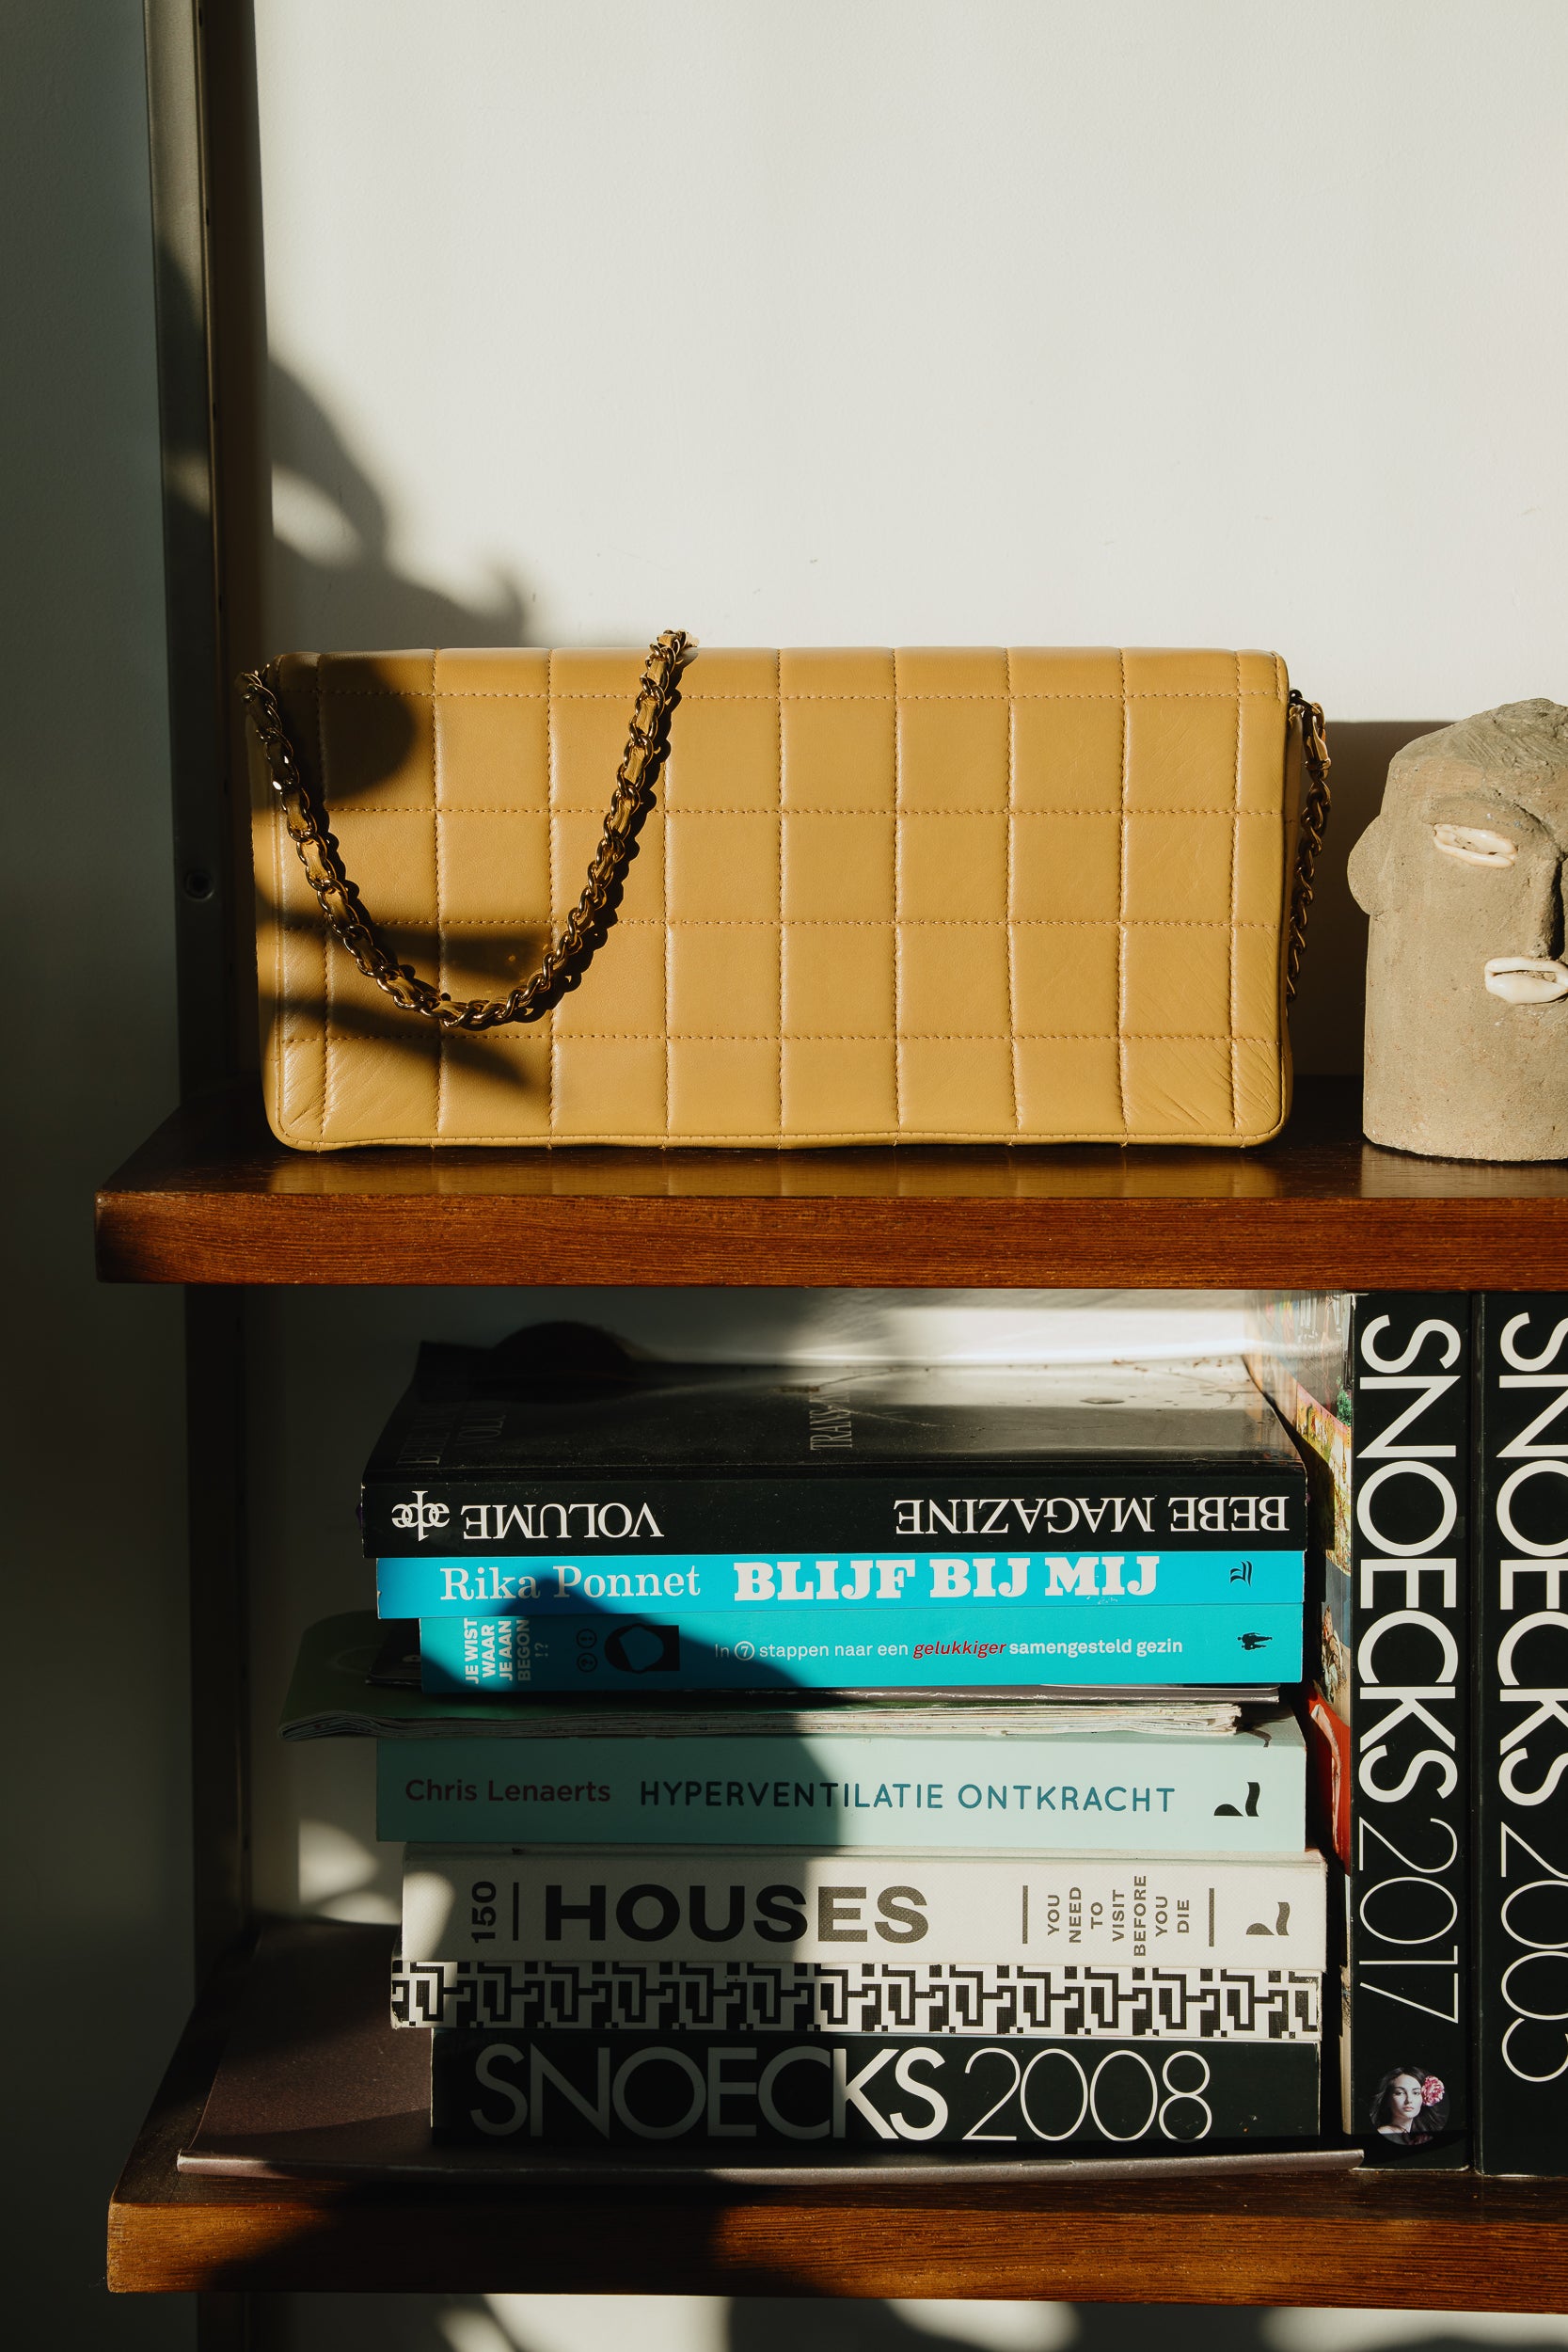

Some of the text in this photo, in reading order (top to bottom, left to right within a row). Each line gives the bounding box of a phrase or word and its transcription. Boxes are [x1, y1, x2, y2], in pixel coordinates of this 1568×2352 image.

[460, 1502, 664, 1540] VOLUME
[894, 1496, 1290, 1535] BEBE MAGAZINE
[440, 1565, 702, 1601] Rika Ponnet
[734, 1555, 1160, 1602] BLIJF BIJ MIJ
[1497, 1311, 1568, 1805] SNOECKS
[464, 1617, 480, 1685] JE WIST
[481, 1625, 497, 1678] WAAR
[498, 1620, 514, 1681] JE AAN
[515, 1619, 531, 1681] BEGON
[715, 1644, 729, 1658] In
[759, 1644, 829, 1661] stappen
[834, 1645, 873, 1657] naar
[877, 1644, 909, 1656] een
[912, 1640, 1006, 1660] gelukkiger
[1008, 1638, 1132, 1658] samengesteld
[1136, 1638, 1183, 1658] gezin
[1356, 1314, 1461, 2024] SNOECKS 2017
[404, 1779, 611, 1804] Chris Lenaerts
[640, 1781, 1176, 1813] HYPERVENTILATIE ONTKRACHT
[471, 1881, 497, 1944] 150
[545, 1883, 929, 1944] HOUSES
[1047, 1894, 1060, 1936] YOU
[1069, 1886, 1082, 1943] NEED
[1090, 1901, 1103, 1930] TO
[1112, 1889, 1125, 1942] VISIT
[1133, 1875, 1147, 1956] BEFORE
[1155, 1896, 1168, 1937] YOU
[1177, 1899, 1190, 1933] DIE
[470, 2042, 1212, 2142] SNOECKS 2008
